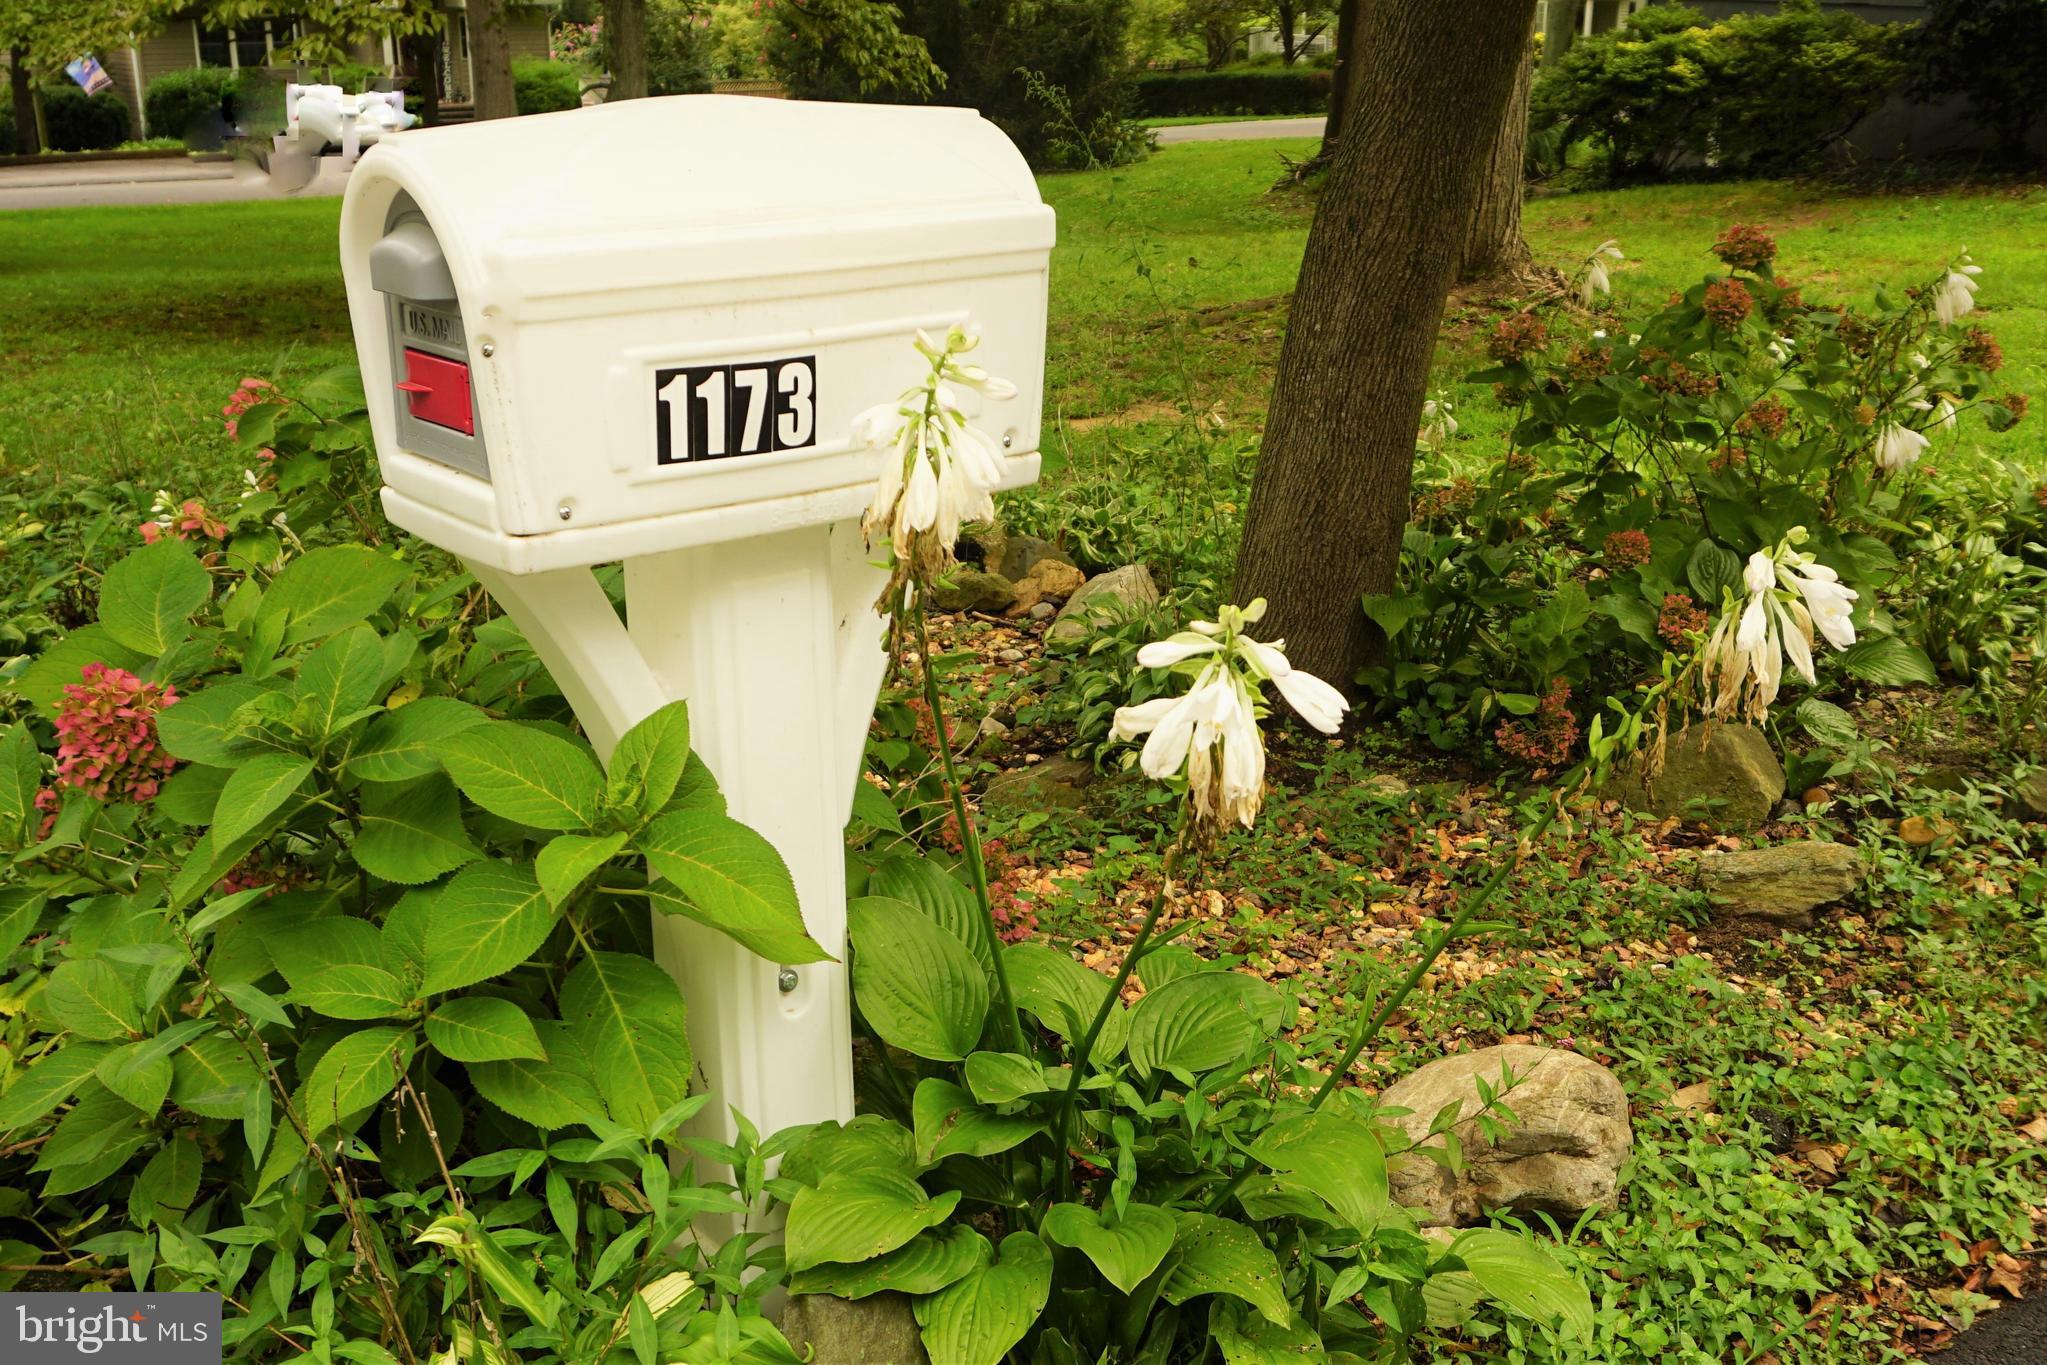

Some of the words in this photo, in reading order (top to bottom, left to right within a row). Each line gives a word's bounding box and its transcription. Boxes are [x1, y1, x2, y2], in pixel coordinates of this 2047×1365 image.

[409, 311, 431, 337] U.S.
[432, 316, 461, 346] MAIL
[658, 362, 813, 460] 1173
